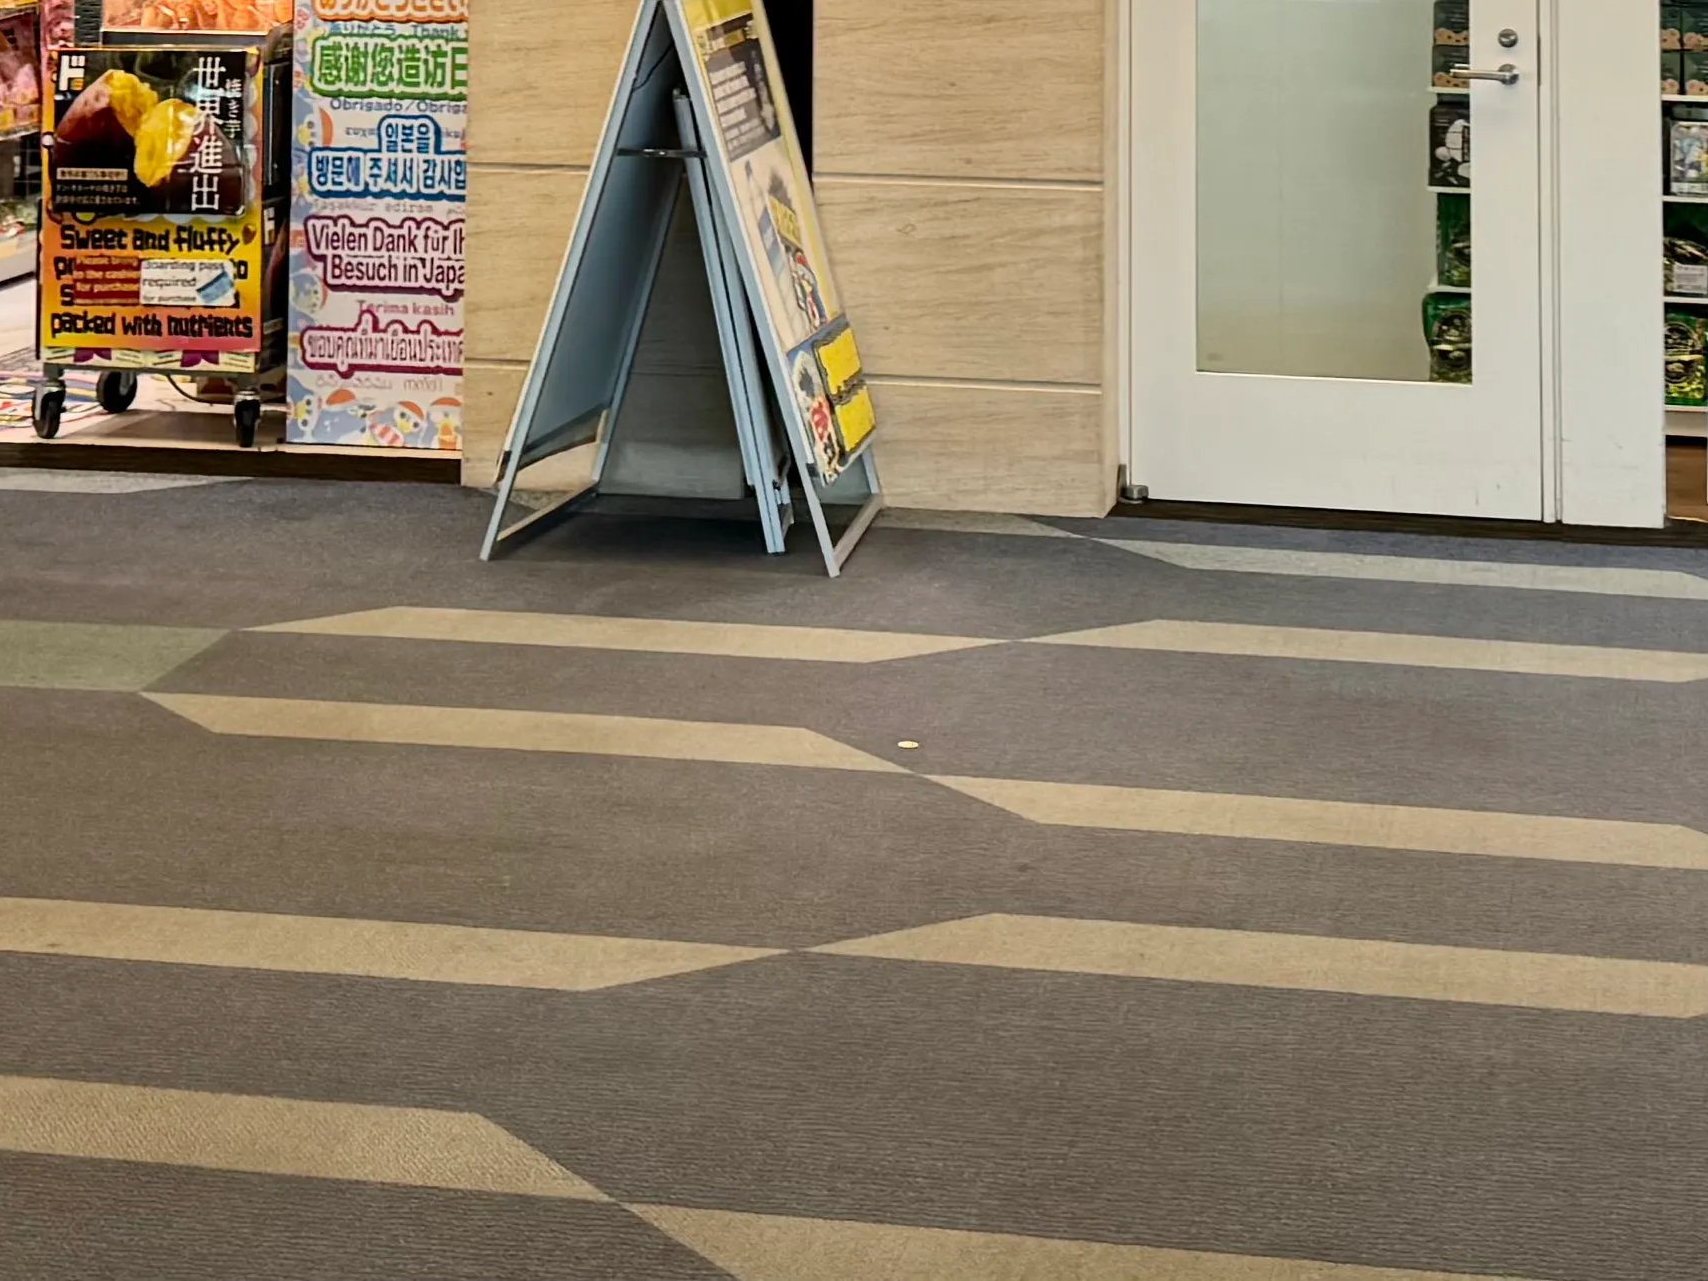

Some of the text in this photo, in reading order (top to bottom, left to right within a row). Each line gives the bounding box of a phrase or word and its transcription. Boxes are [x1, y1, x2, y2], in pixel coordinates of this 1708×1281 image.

[191, 56, 227, 211] 世界進出
[385, 123, 431, 153] 일본을
[369, 158, 414, 188] 주셔서
[61, 225, 240, 254] Sweet and fluffy
[313, 223, 368, 252] Vielen
[373, 224, 418, 254] Dank
[424, 226, 449, 255] für
[332, 254, 399, 282] Besuch
[404, 257, 419, 282] in
[143, 277, 196, 289] required
[413, 302, 455, 317] kasih
[51, 311, 254, 339] packed with nutrients
